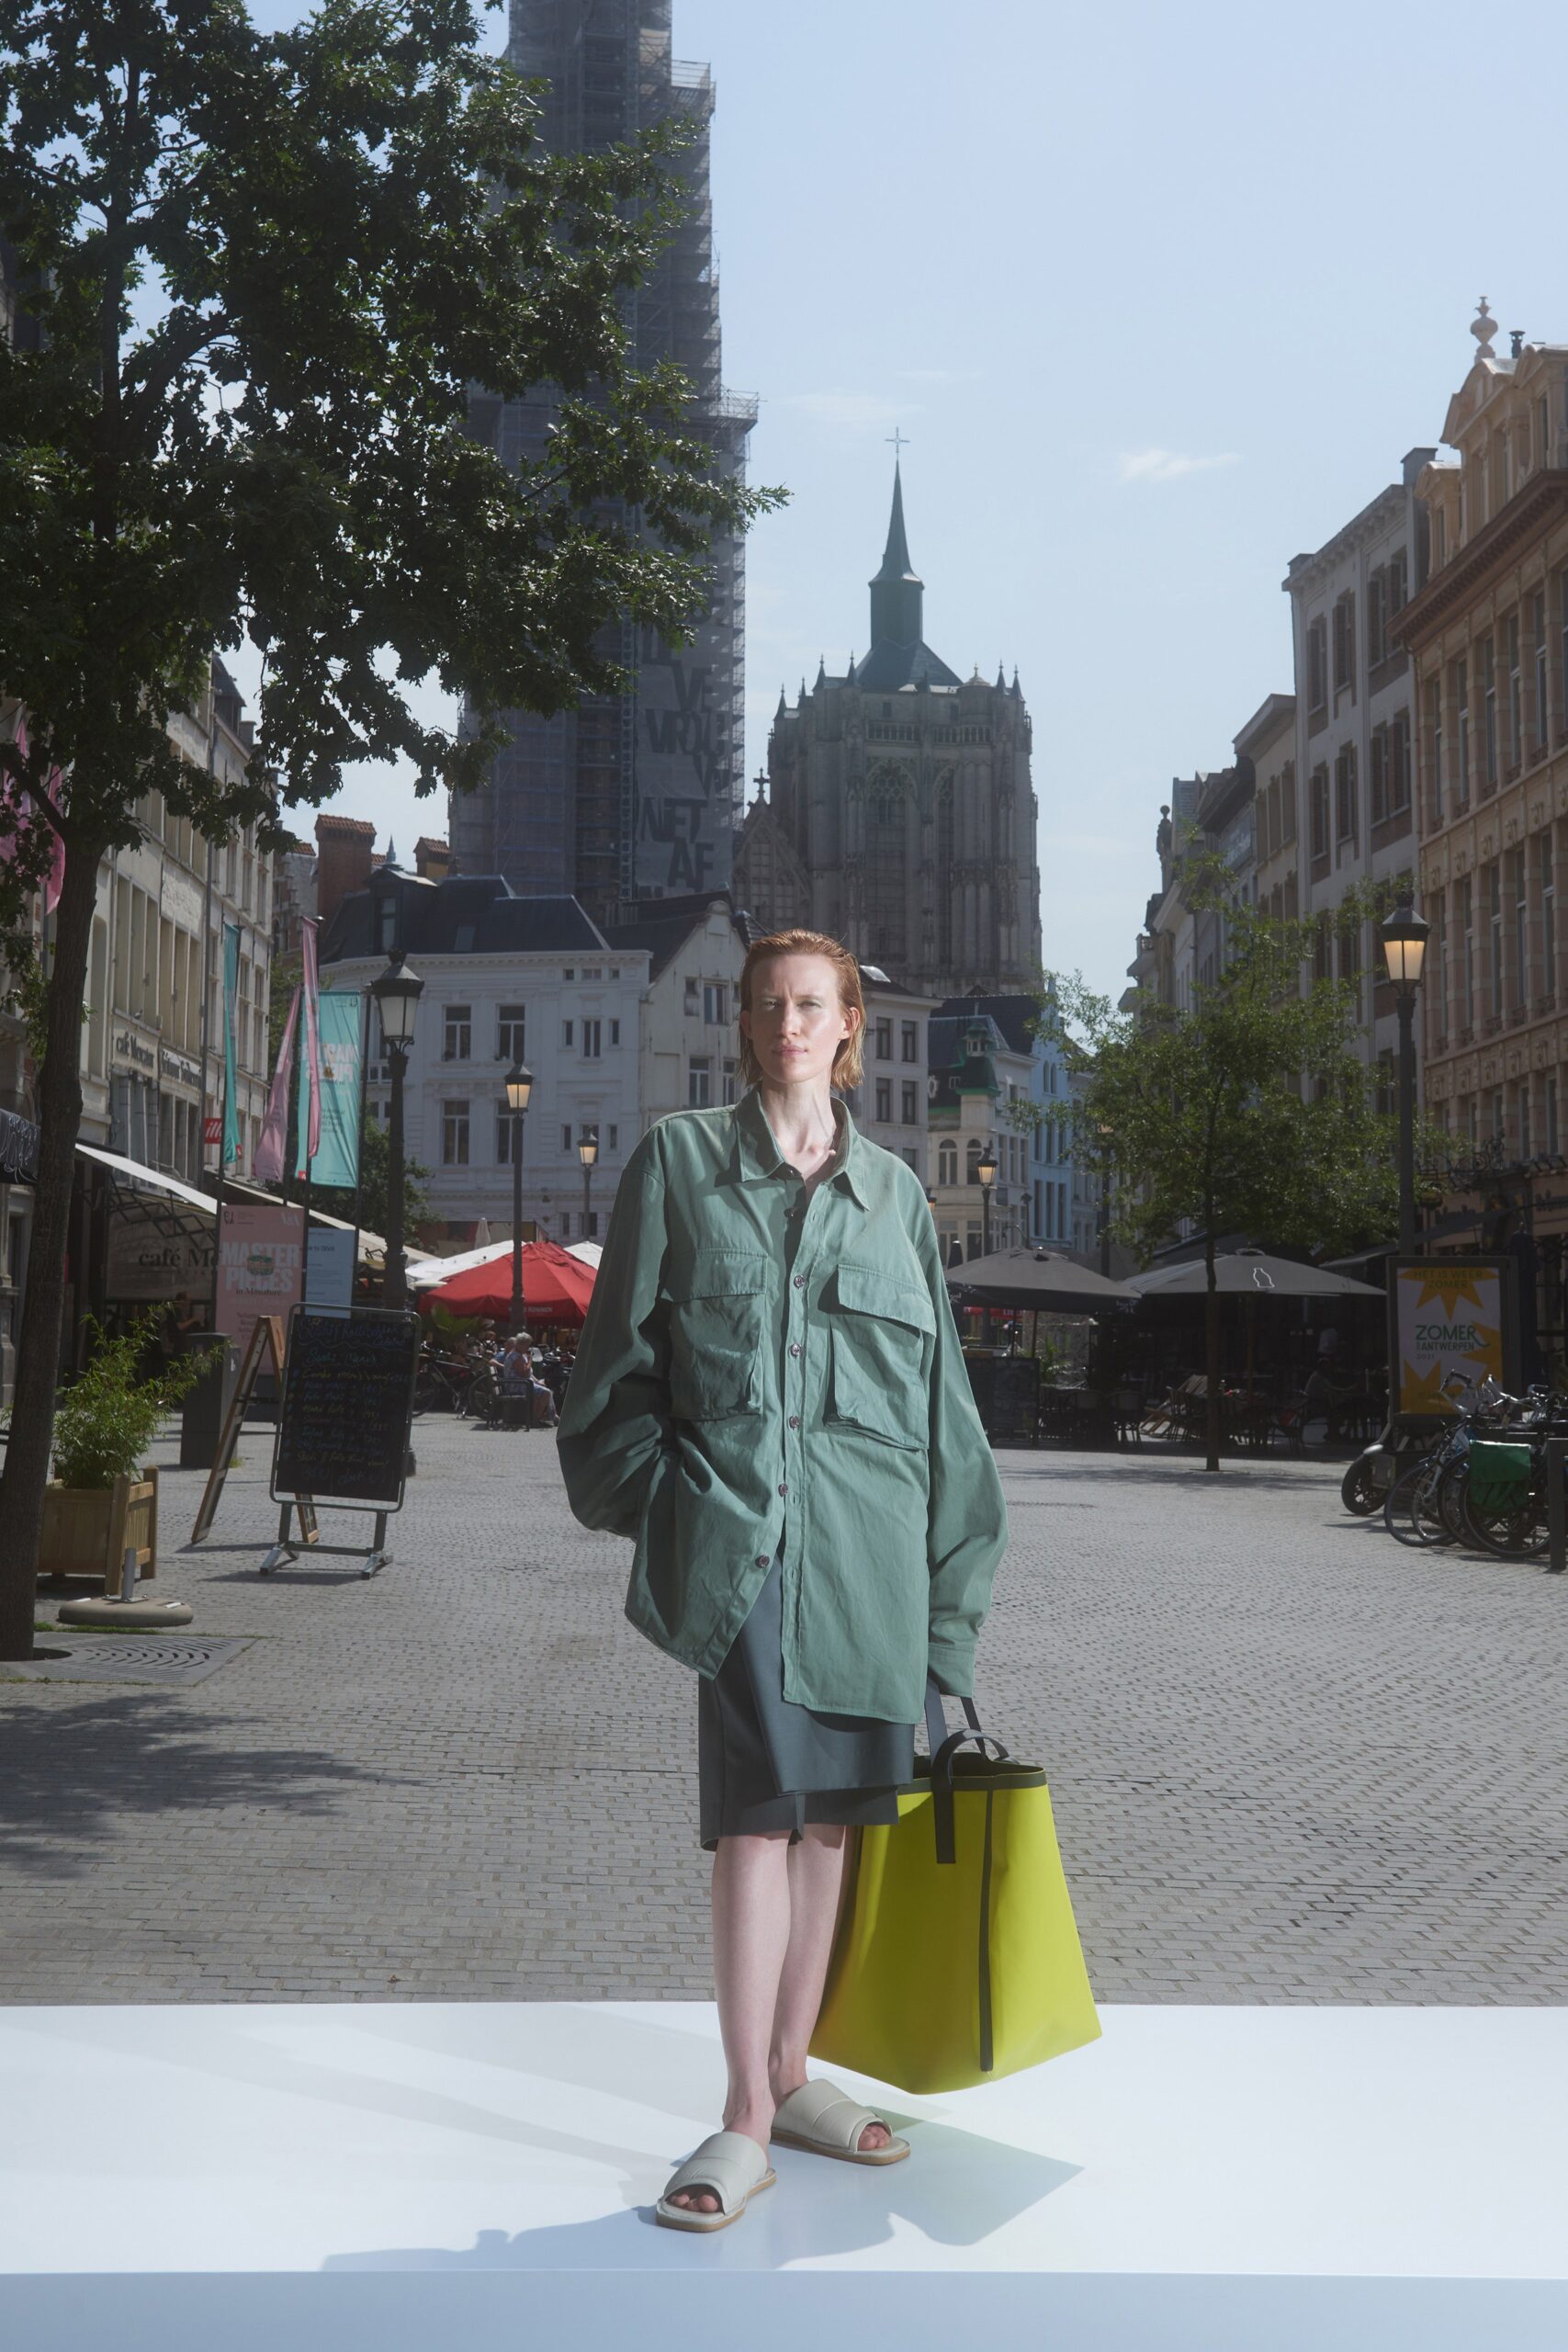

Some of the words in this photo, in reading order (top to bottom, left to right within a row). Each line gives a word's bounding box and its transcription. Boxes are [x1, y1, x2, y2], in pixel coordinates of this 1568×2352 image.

[641, 797, 707, 843] NET
[667, 837, 714, 893] AF
[205, 1121, 222, 1138] ill
[139, 1248, 181, 1267] café
[221, 1241, 299, 1267] MASTER
[1416, 1325, 1490, 1348] ZOMER
[1421, 1341, 1474, 1351] ANTWERPEN
